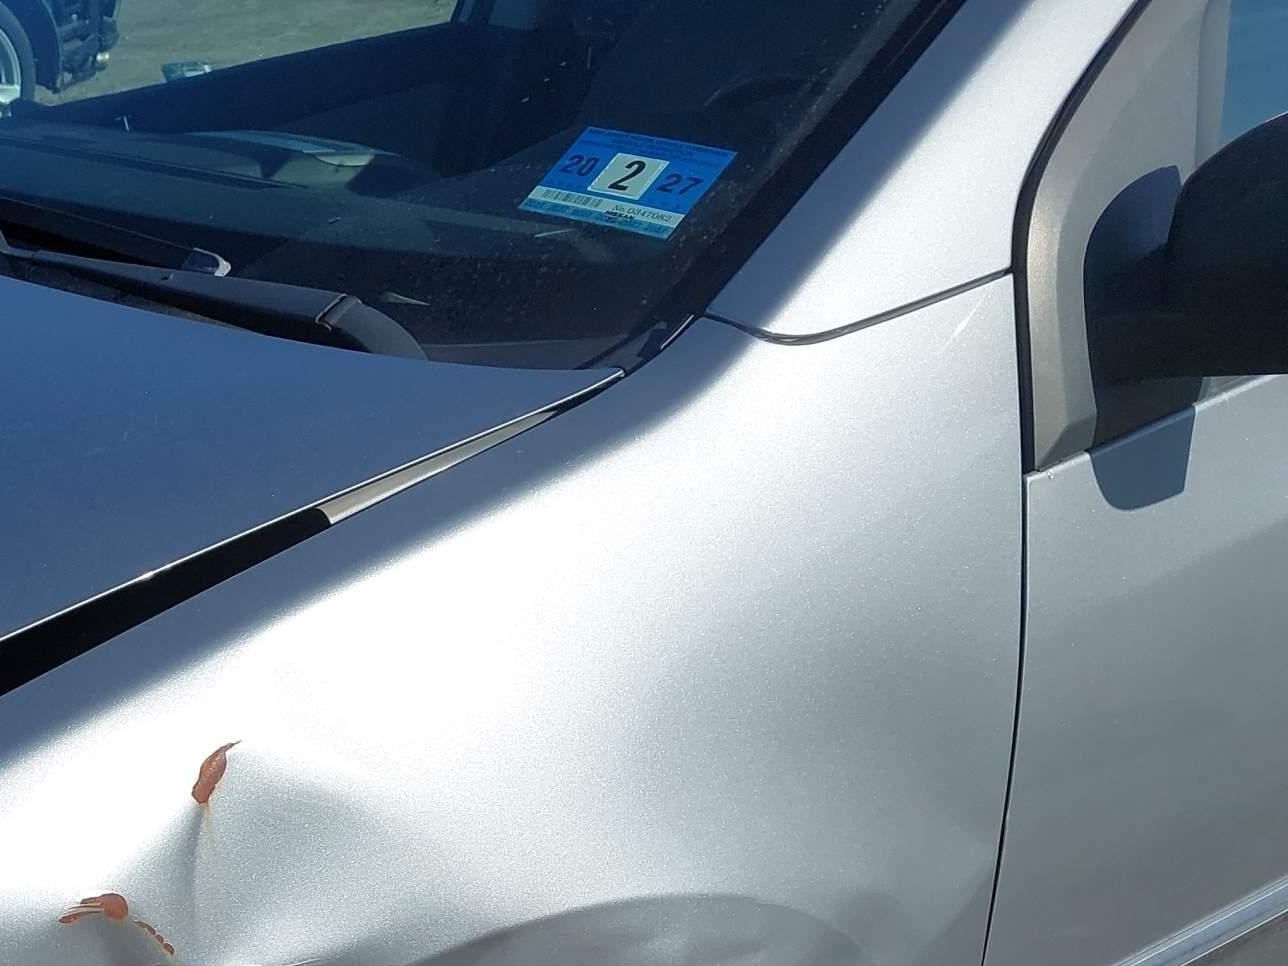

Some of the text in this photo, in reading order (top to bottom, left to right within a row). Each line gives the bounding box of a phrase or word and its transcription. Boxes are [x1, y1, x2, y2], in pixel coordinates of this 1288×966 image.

[559, 155, 704, 196] 20 2 27
